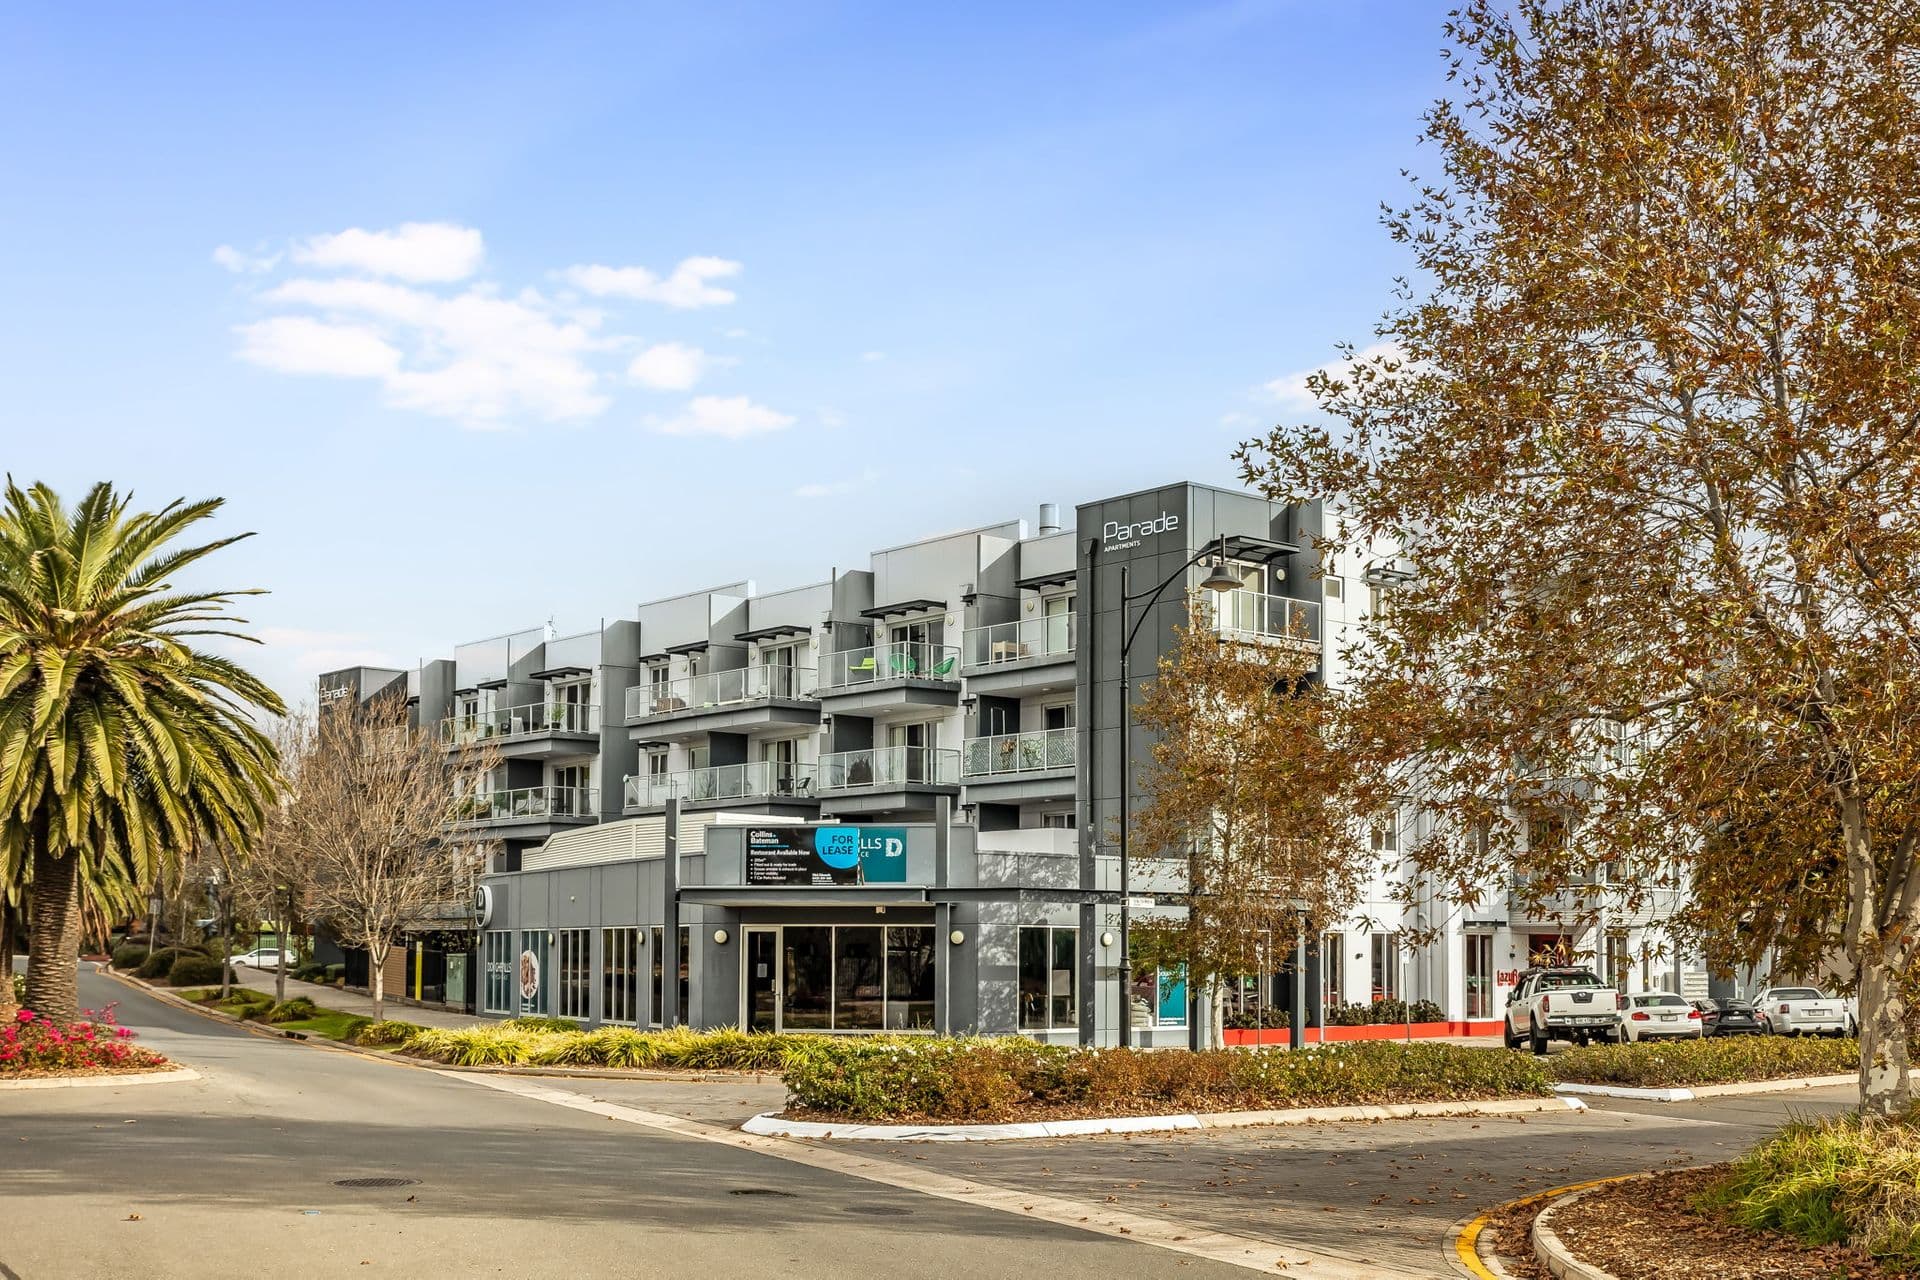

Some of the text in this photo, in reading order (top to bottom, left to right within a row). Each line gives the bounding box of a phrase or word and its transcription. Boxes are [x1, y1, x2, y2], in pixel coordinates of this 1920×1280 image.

[1103, 510, 1179, 544] Parade
[1103, 539, 1142, 553] APARTMENTS
[831, 835, 853, 845] FOR
[822, 845, 854, 855] LEASE
